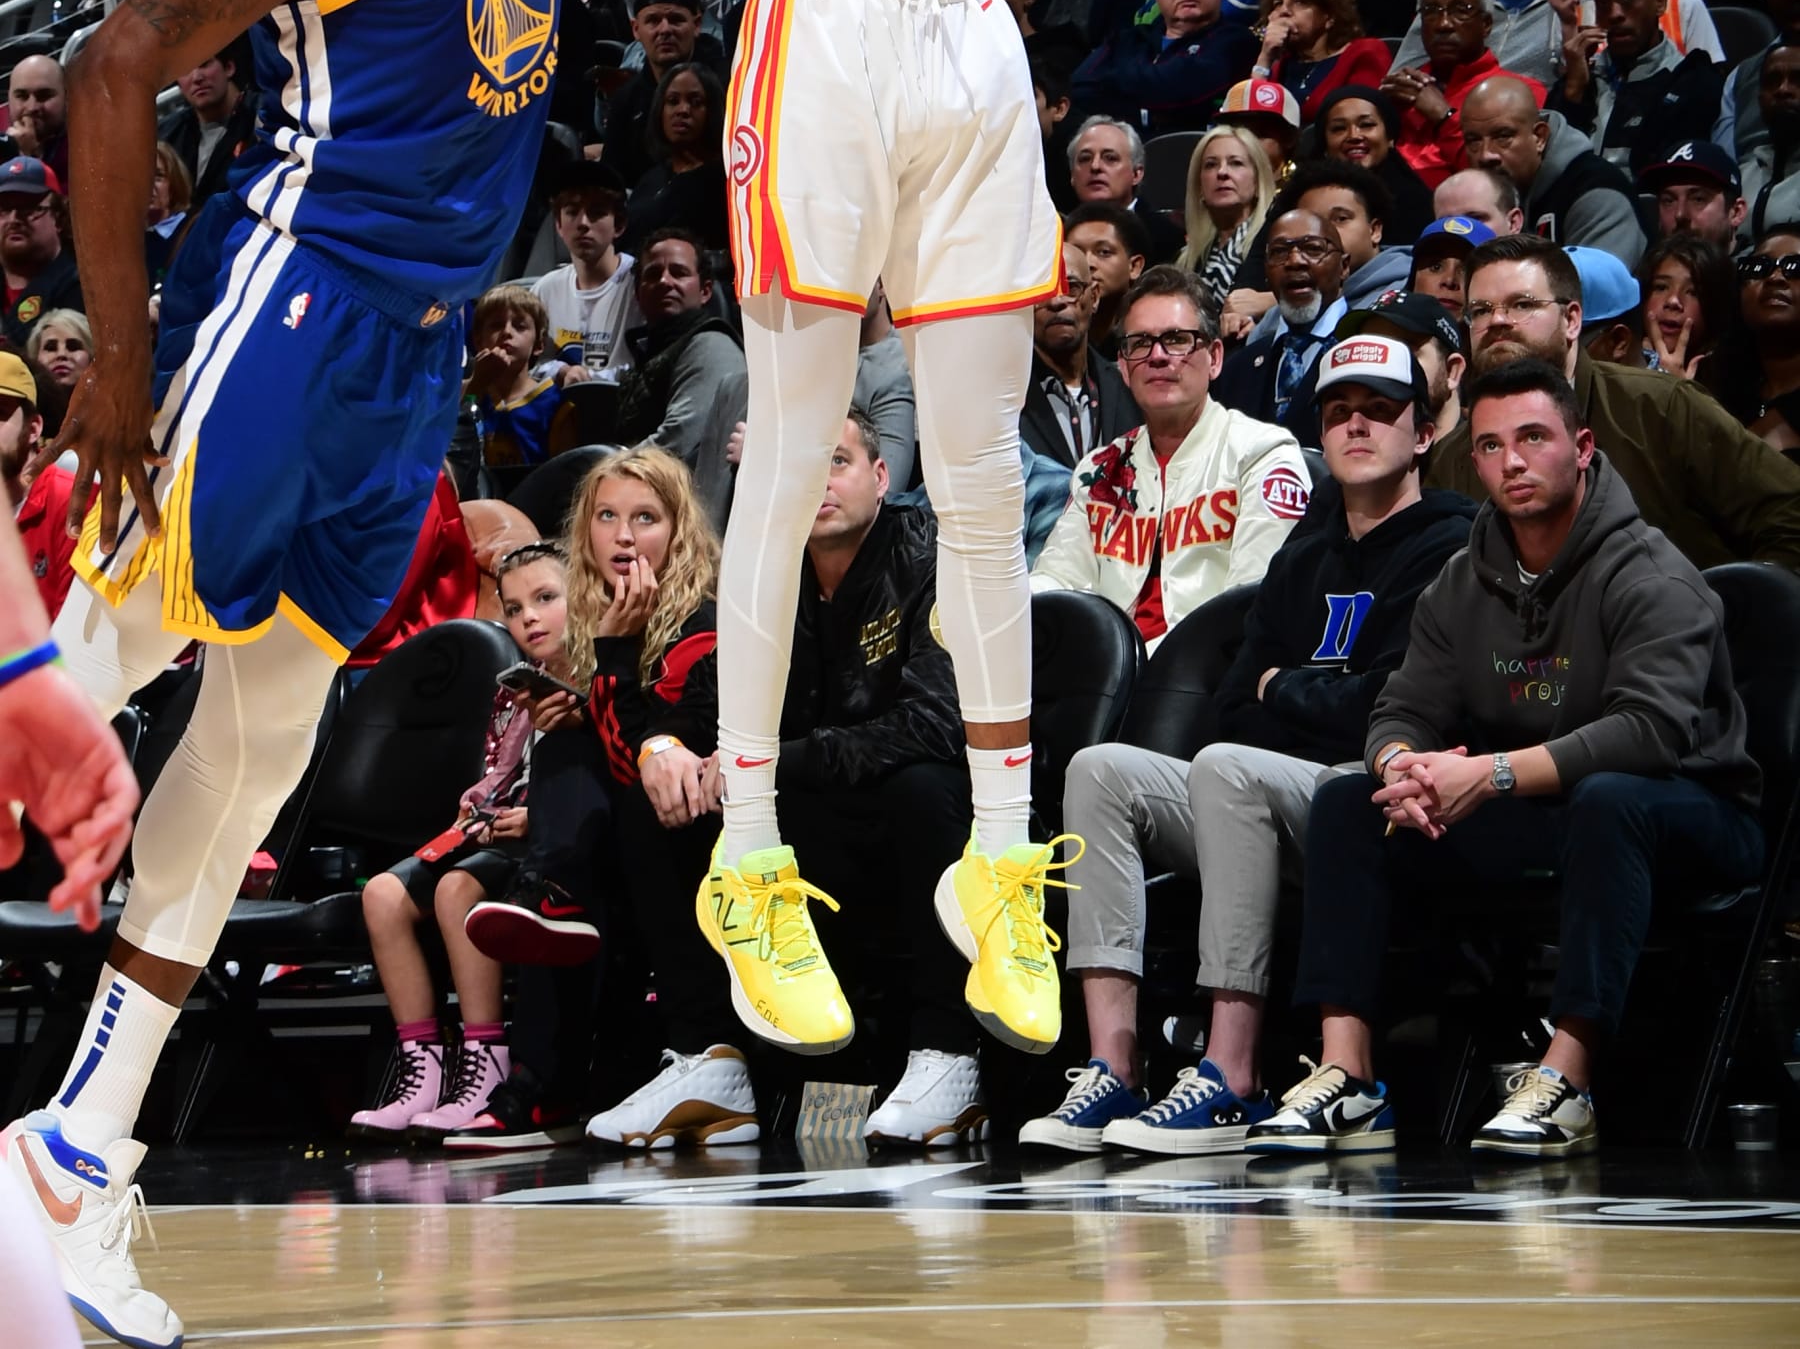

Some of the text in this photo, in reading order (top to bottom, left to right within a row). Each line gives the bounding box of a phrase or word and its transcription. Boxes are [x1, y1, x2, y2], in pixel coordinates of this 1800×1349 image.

[1351, 352, 1383, 363] wiggly
[1353, 344, 1384, 356] piggly
[1267, 480, 1307, 510] ATL
[1086, 489, 1239, 568] HAWKS
[804, 1090, 837, 1112] POP
[930, 1179, 1800, 1223] Georg
